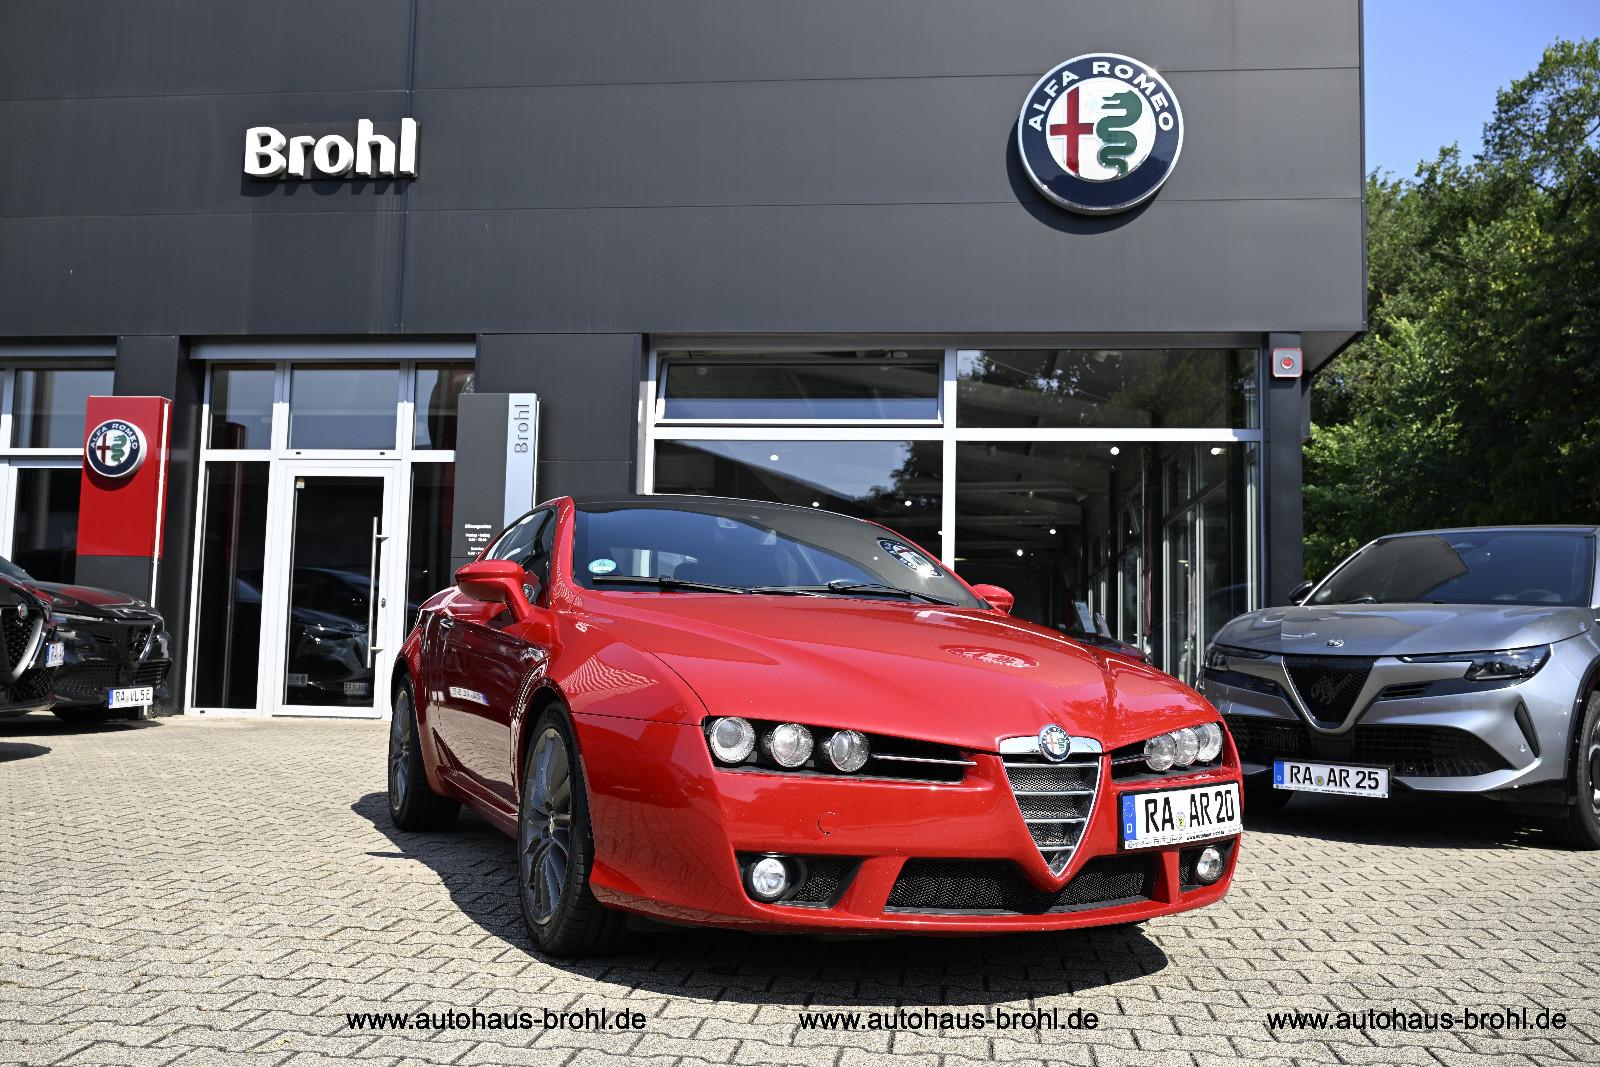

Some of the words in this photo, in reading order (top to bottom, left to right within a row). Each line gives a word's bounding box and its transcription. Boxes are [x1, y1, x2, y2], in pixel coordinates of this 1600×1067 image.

[1028, 70, 1080, 132] ALFA
[1092, 61, 1174, 131] ROMEO
[244, 117, 417, 178] Brohl
[90, 426, 108, 448] ALFA
[111, 423, 138, 450] ROMEO
[514, 404, 530, 454] Brohl
[1289, 765, 1313, 785] RA
[1326, 768, 1351, 788] AR
[1355, 770, 1379, 790] 25
[1144, 797, 1175, 834] RA
[1189, 793, 1213, 828] AR
[1214, 789, 1235, 824] 20
